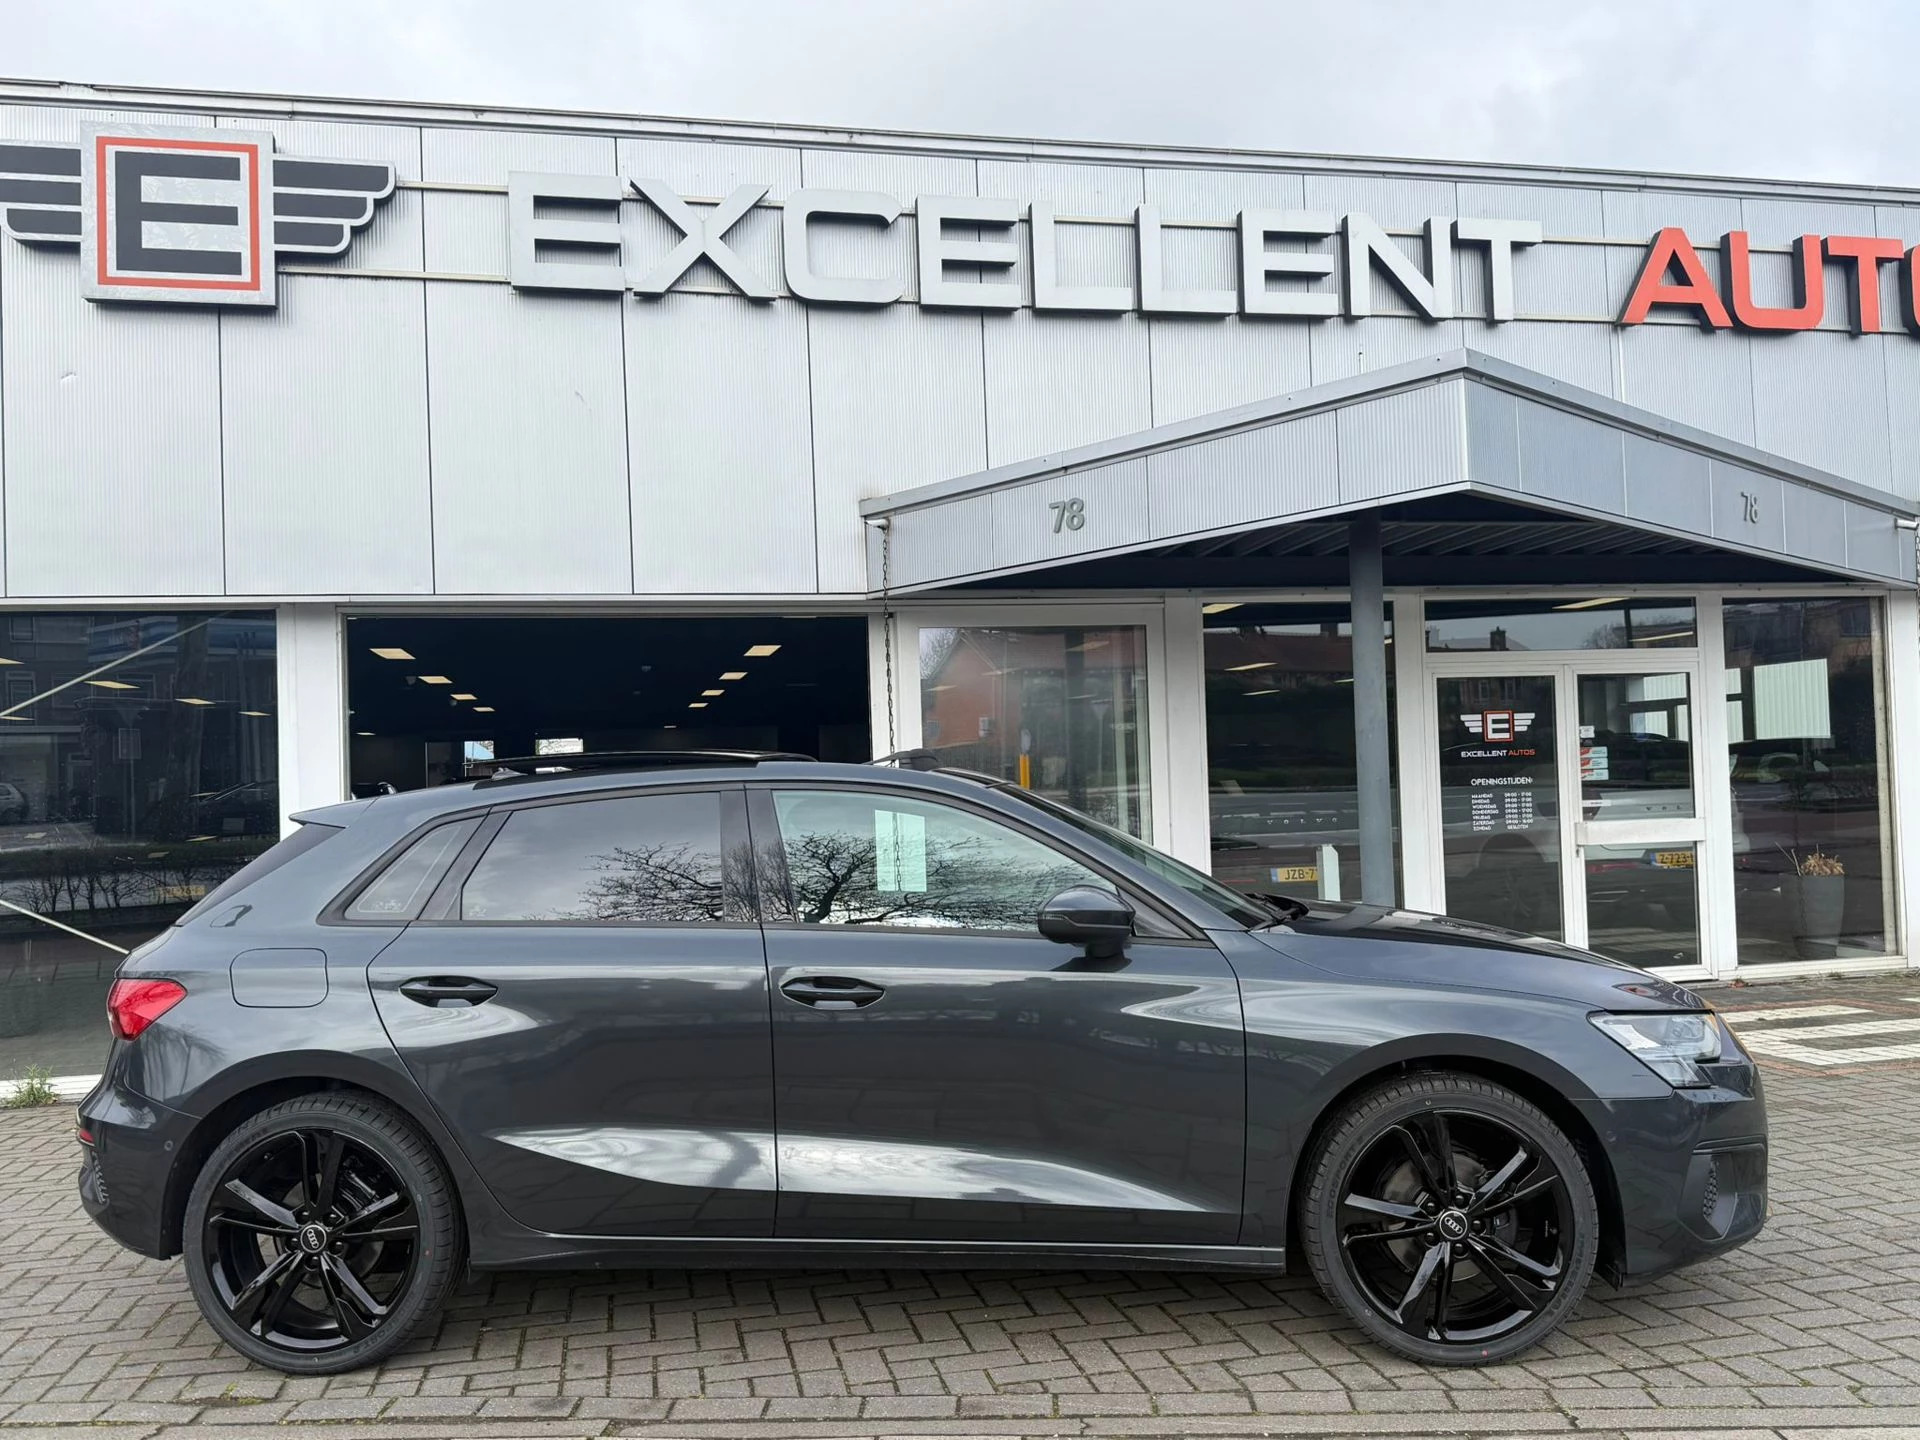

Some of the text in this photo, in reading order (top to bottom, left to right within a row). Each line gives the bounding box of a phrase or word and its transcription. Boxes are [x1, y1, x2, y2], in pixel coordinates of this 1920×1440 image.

[115, 151, 241, 275] E
[508, 170, 1920, 336] EXCELLENT AUT
[1049, 498, 1084, 533] 78
[1741, 492, 1758, 523] 78
[1487, 713, 1510, 739] E
[1461, 749, 1507, 758] EXCELLENT
